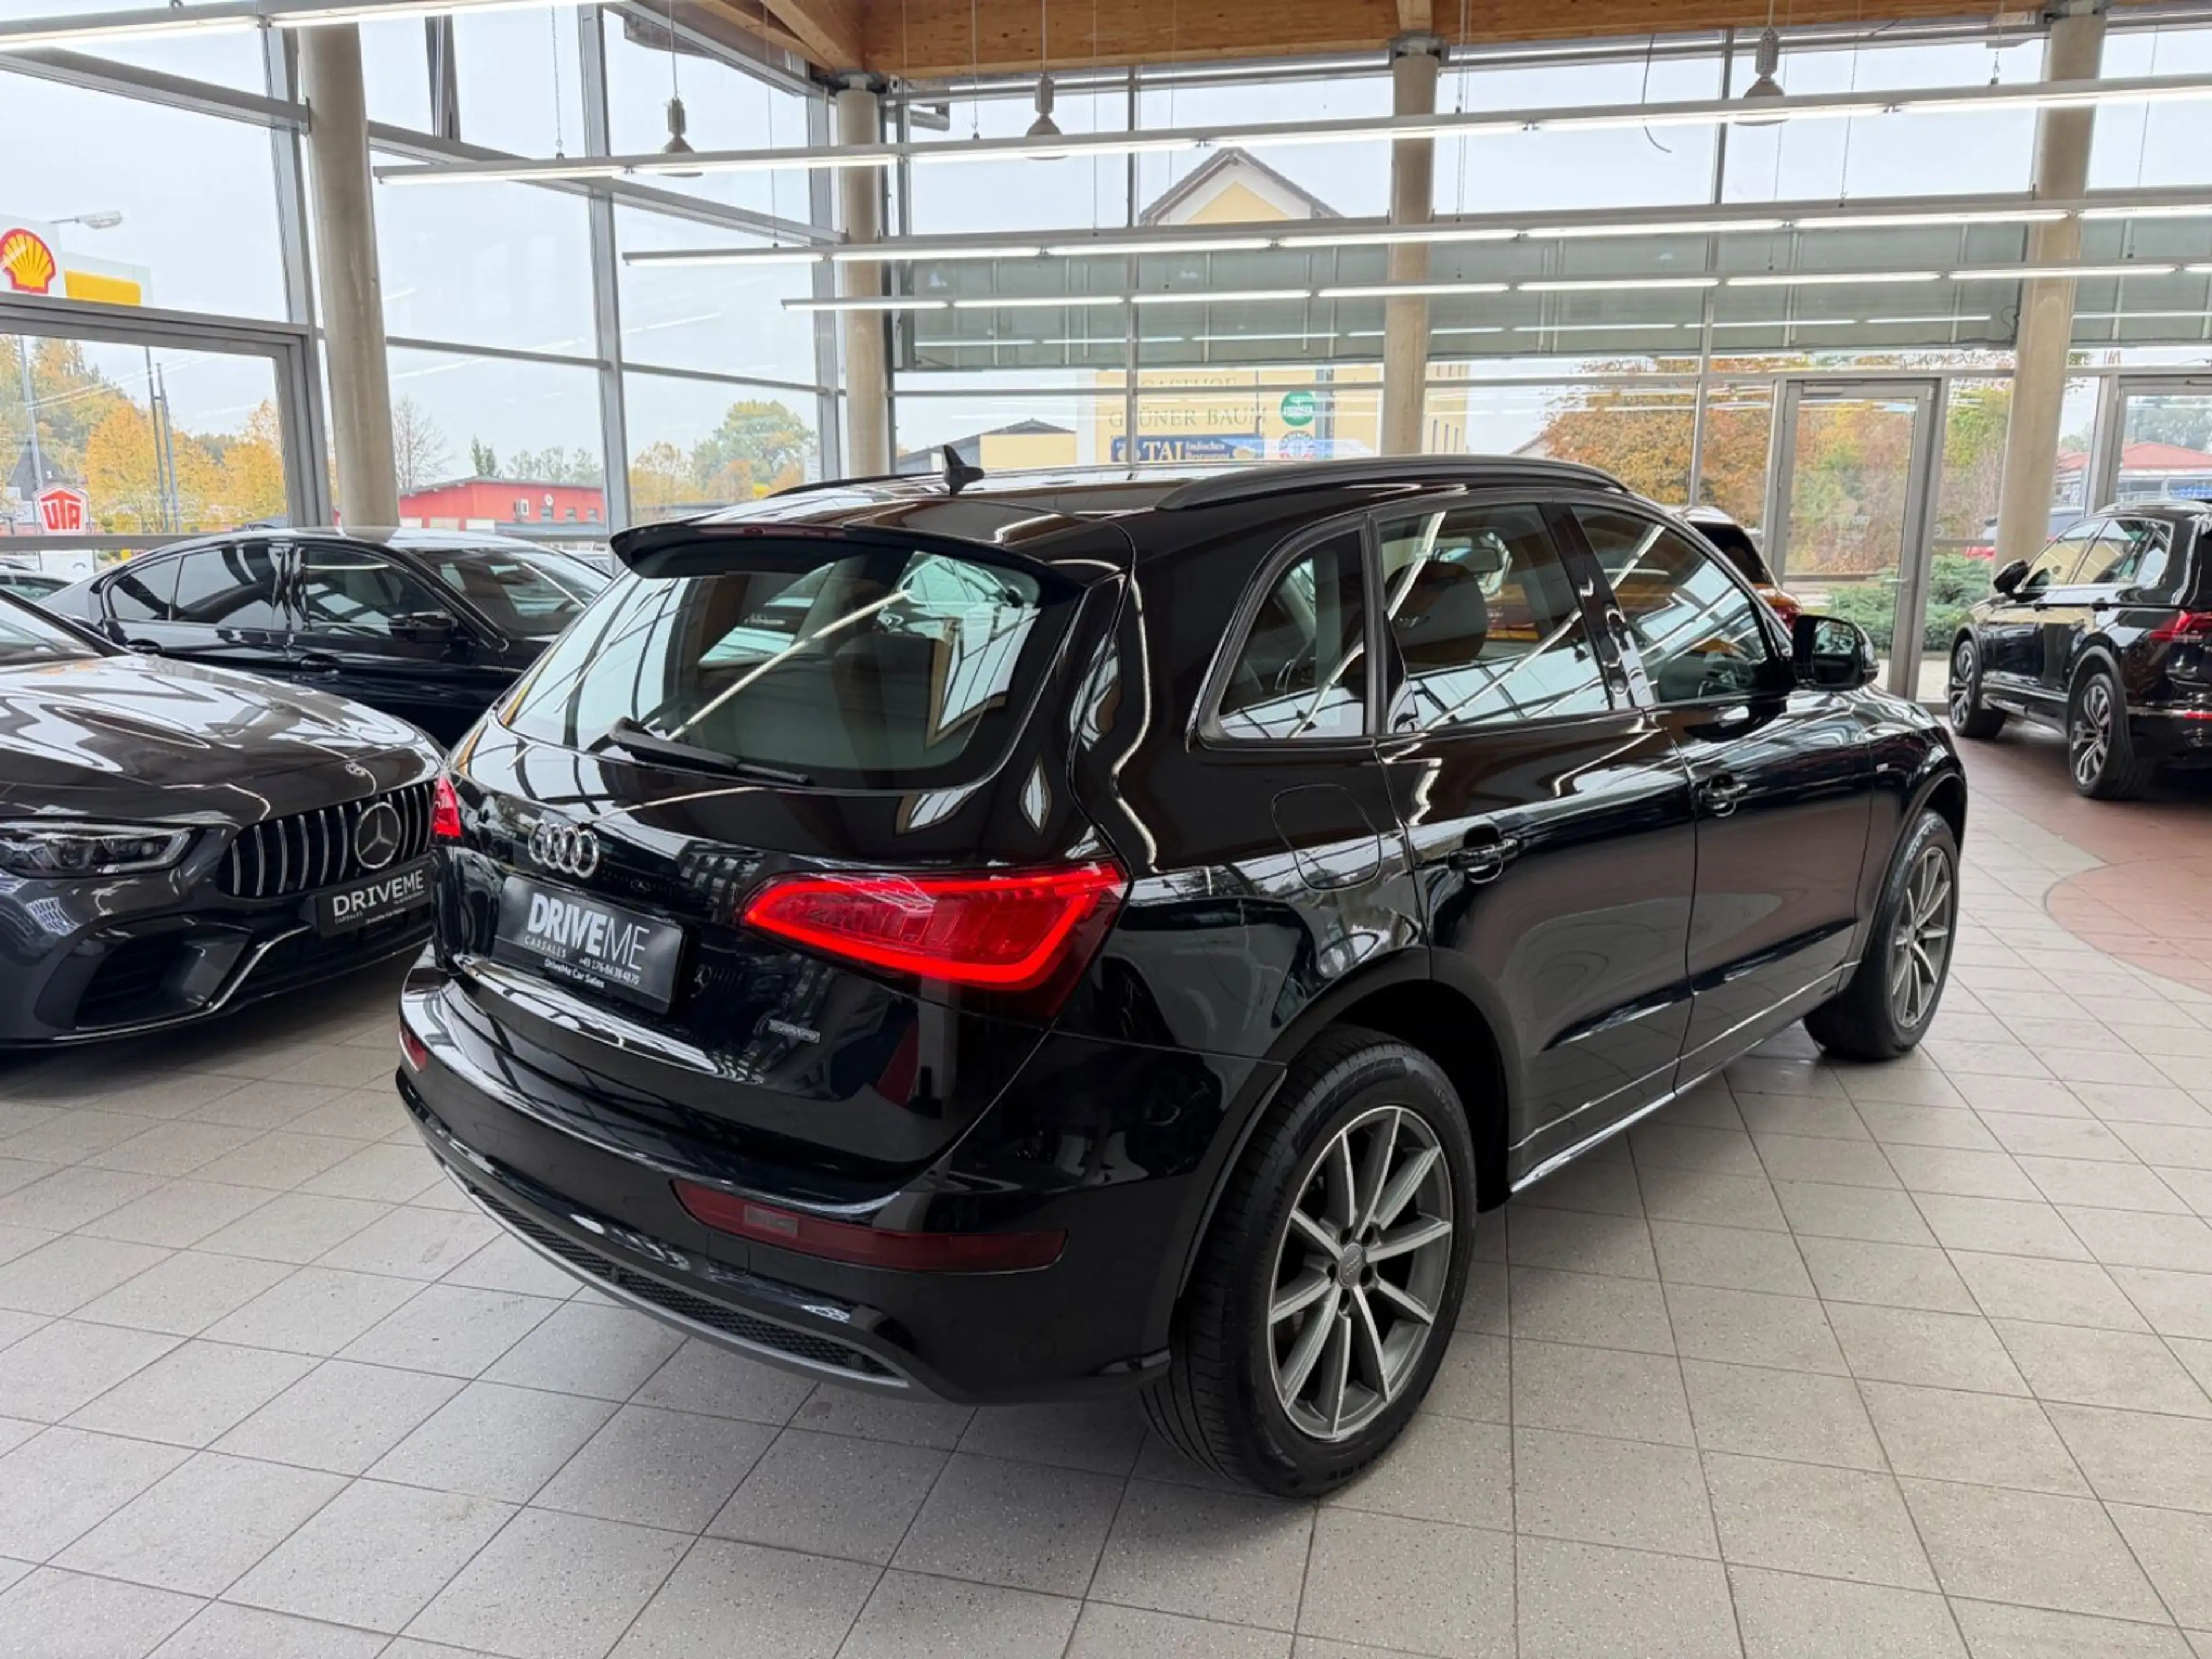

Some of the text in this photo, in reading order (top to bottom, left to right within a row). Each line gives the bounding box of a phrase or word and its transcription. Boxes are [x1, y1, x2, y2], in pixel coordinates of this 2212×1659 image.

[1109, 406, 1197, 427] GÜNER
[41, 490, 81, 530] UTA
[332, 869, 425, 917] DRIVEME
[528, 892, 650, 971] DRIVEME
